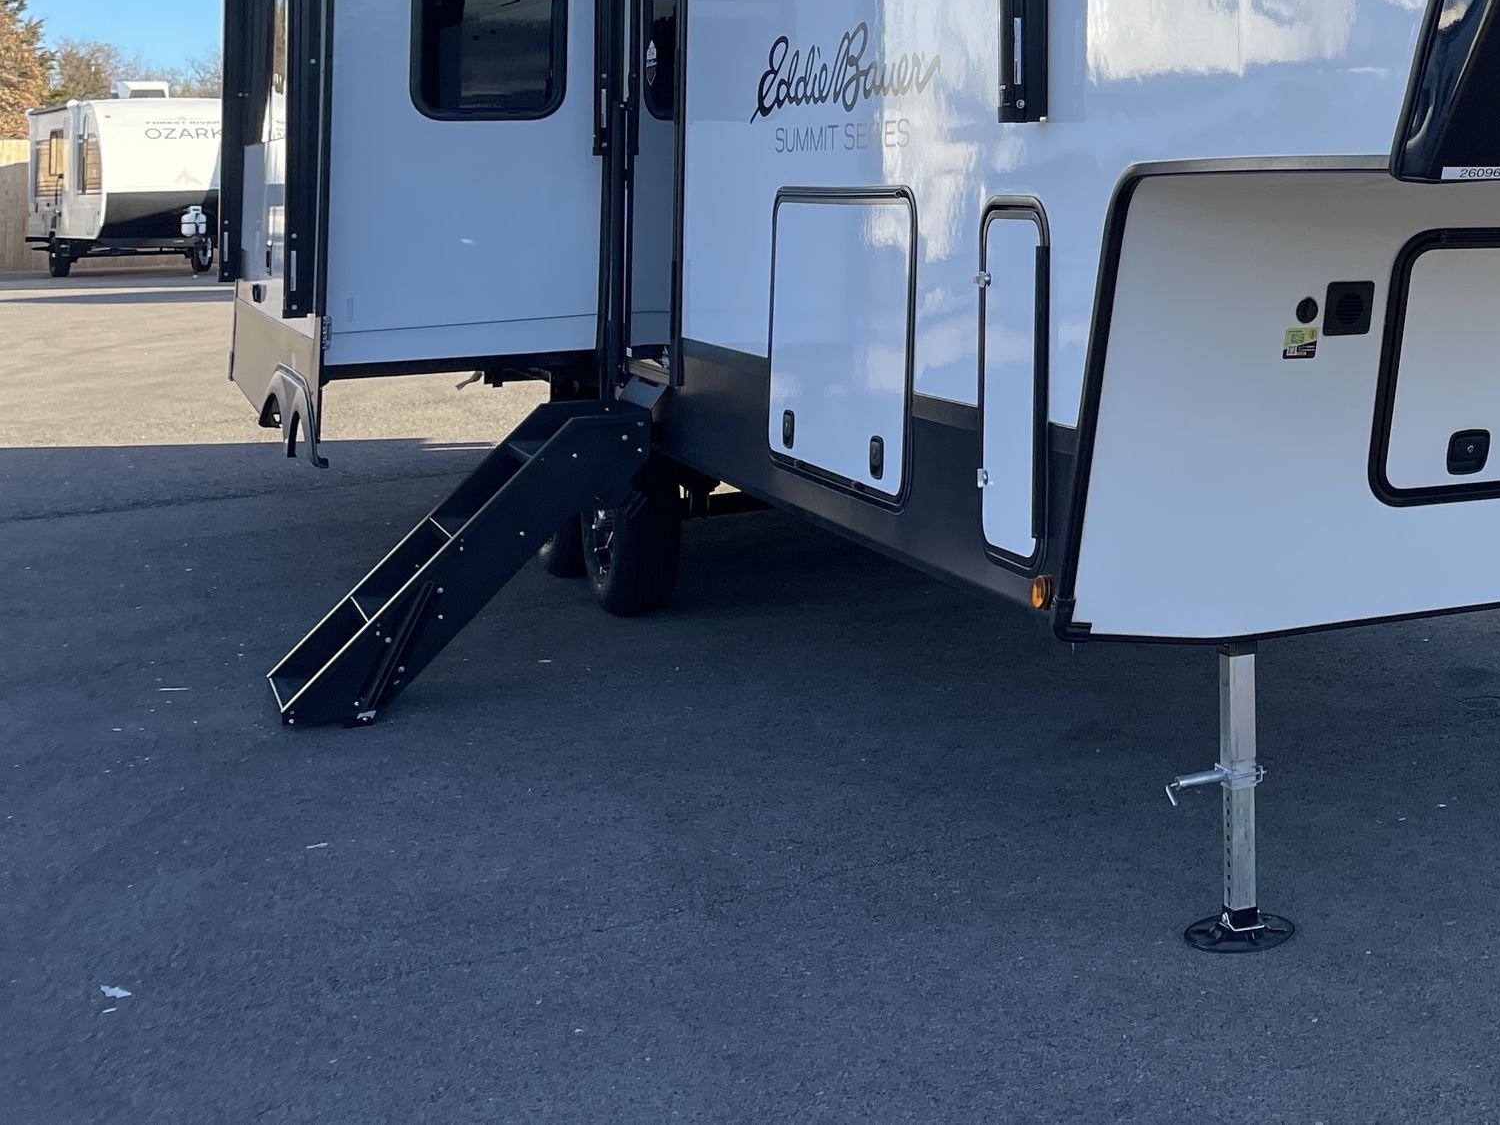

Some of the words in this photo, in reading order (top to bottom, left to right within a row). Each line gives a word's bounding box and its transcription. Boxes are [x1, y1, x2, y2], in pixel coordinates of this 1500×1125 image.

[750, 35, 832, 124] Eddie
[832, 21, 941, 112] Bauer
[775, 125, 838, 153] SUMMIT
